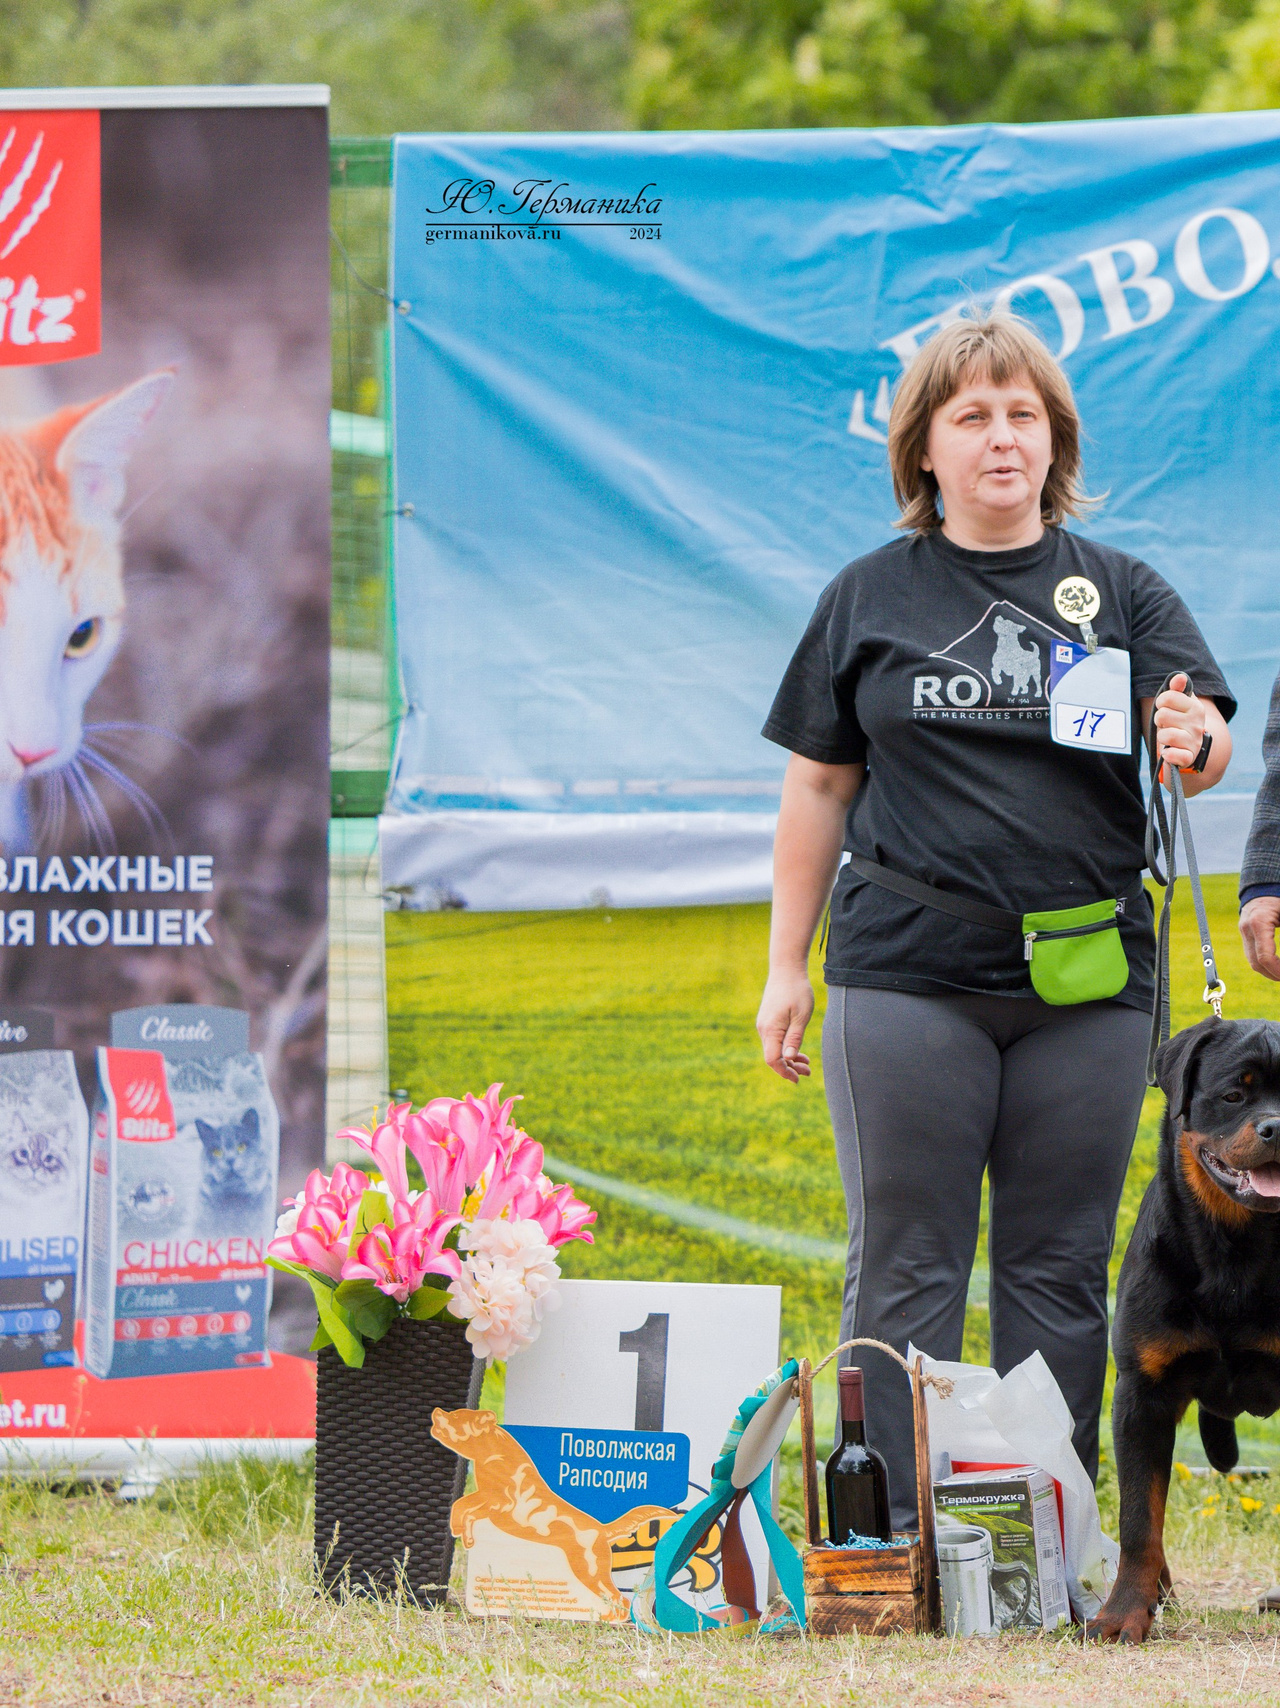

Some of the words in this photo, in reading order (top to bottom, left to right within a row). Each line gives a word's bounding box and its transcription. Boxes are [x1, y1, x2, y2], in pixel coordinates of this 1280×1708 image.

[941, 711, 1011, 720] MERCEDES
[1073, 710, 1107, 739] 17
[50, 908, 215, 946] КОШЕК
[141, 1016, 214, 1042] Classic
[123, 1237, 264, 1270] CHICKEN
[618, 1312, 670, 1432] 1
[560, 1432, 676, 1462] Поволжская
[558, 1461, 648, 1493] Рапсодия
[939, 1493, 1026, 1506] Термокружка
